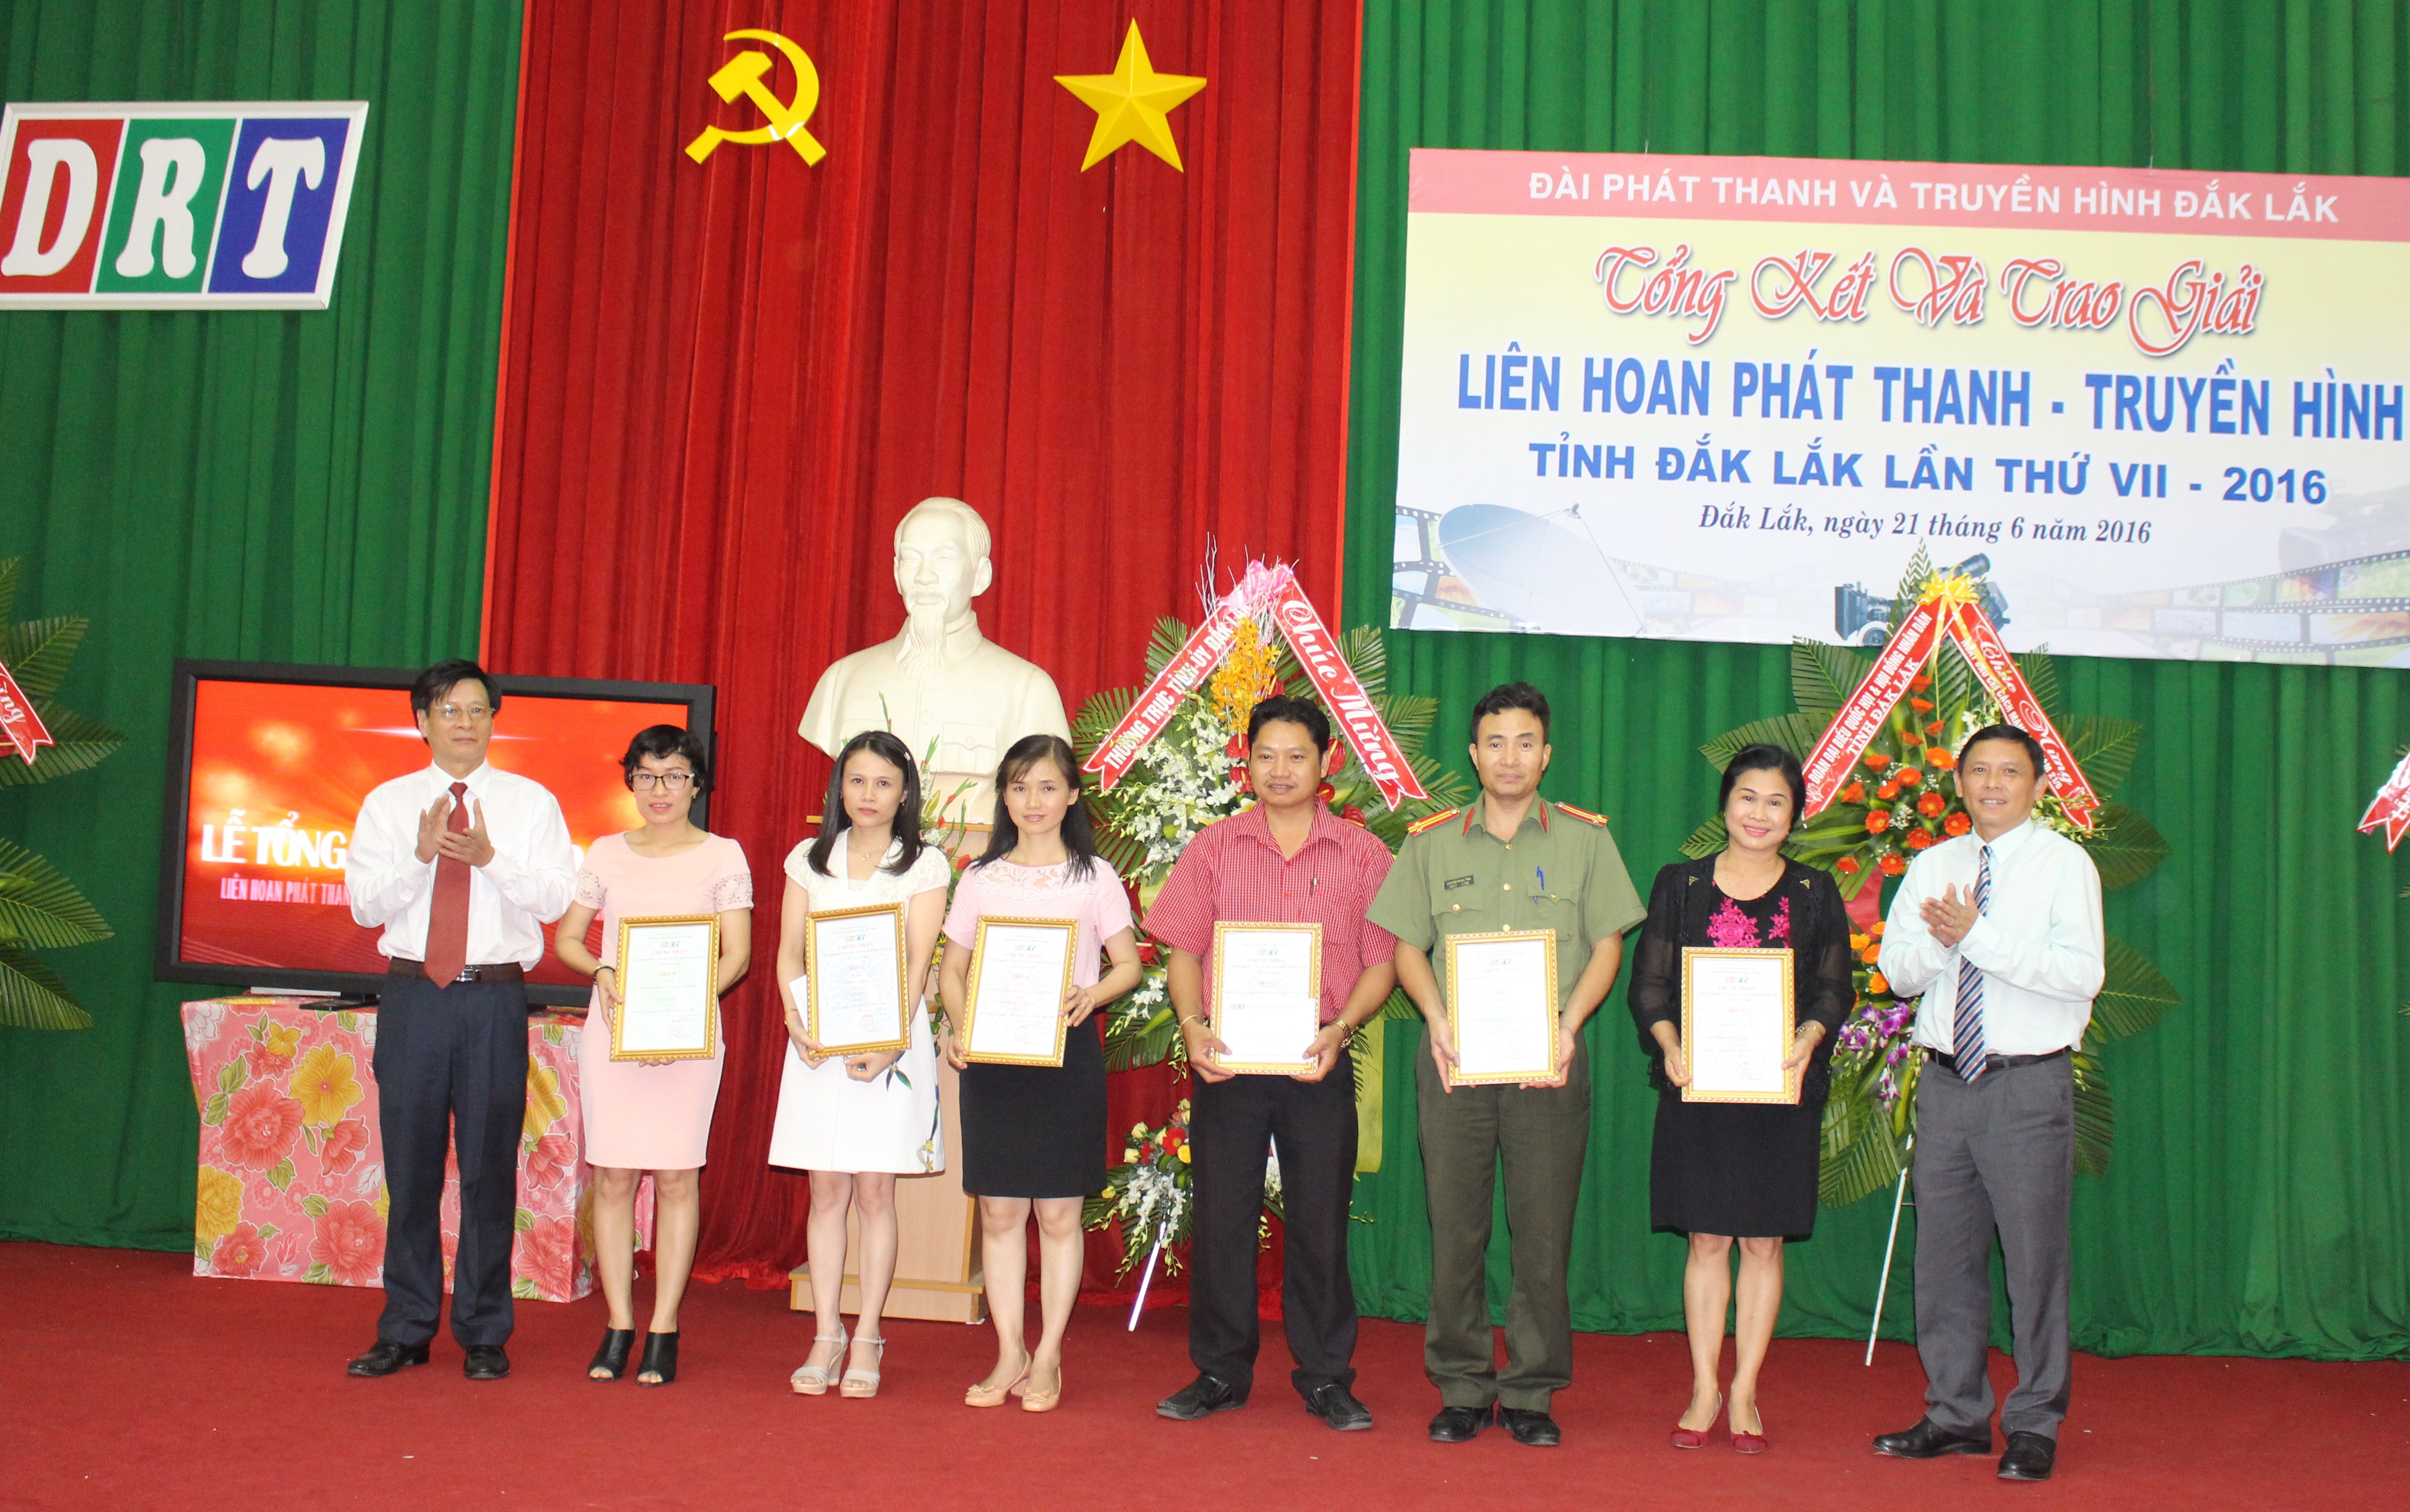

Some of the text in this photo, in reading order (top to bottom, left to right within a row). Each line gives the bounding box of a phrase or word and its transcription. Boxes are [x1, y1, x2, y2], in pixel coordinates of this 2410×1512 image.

[1, 136, 326, 278] DRT
[1529, 166, 2338, 222] ĐÀI PHÁT THANH VÀ TRUYỀN HÌNH ĐẮK LẮK
[1596, 244, 2263, 356] Tổng Kết Và Trao Giải
[1458, 341, 2404, 441] LIÊN HOAN PHÁT THANH - TRUYỀN HÌNH
[1529, 431, 1634, 479] TỈNH
[1656, 434, 1752, 483] ĐẮK
[1773, 437, 1863, 487] LẮK
[1885, 444, 1973, 490] LẦN
[1996, 454, 2090, 495] THỨ
[2109, 463, 2167, 498] VII
[2222, 466, 2326, 505] 2016
[1699, 502, 2152, 544] Đắk Lắk, ngày 21 tháng 6 năm 2016
[1141, 690, 1175, 725] TRỰC
[1282, 600, 1400, 786] Chúc Mừng
[1869, 685, 1880, 697] &
[201, 808, 347, 870] LỄ TỔNG
[220, 872, 352, 907] LIÊN HOAN PHÁT THAN
